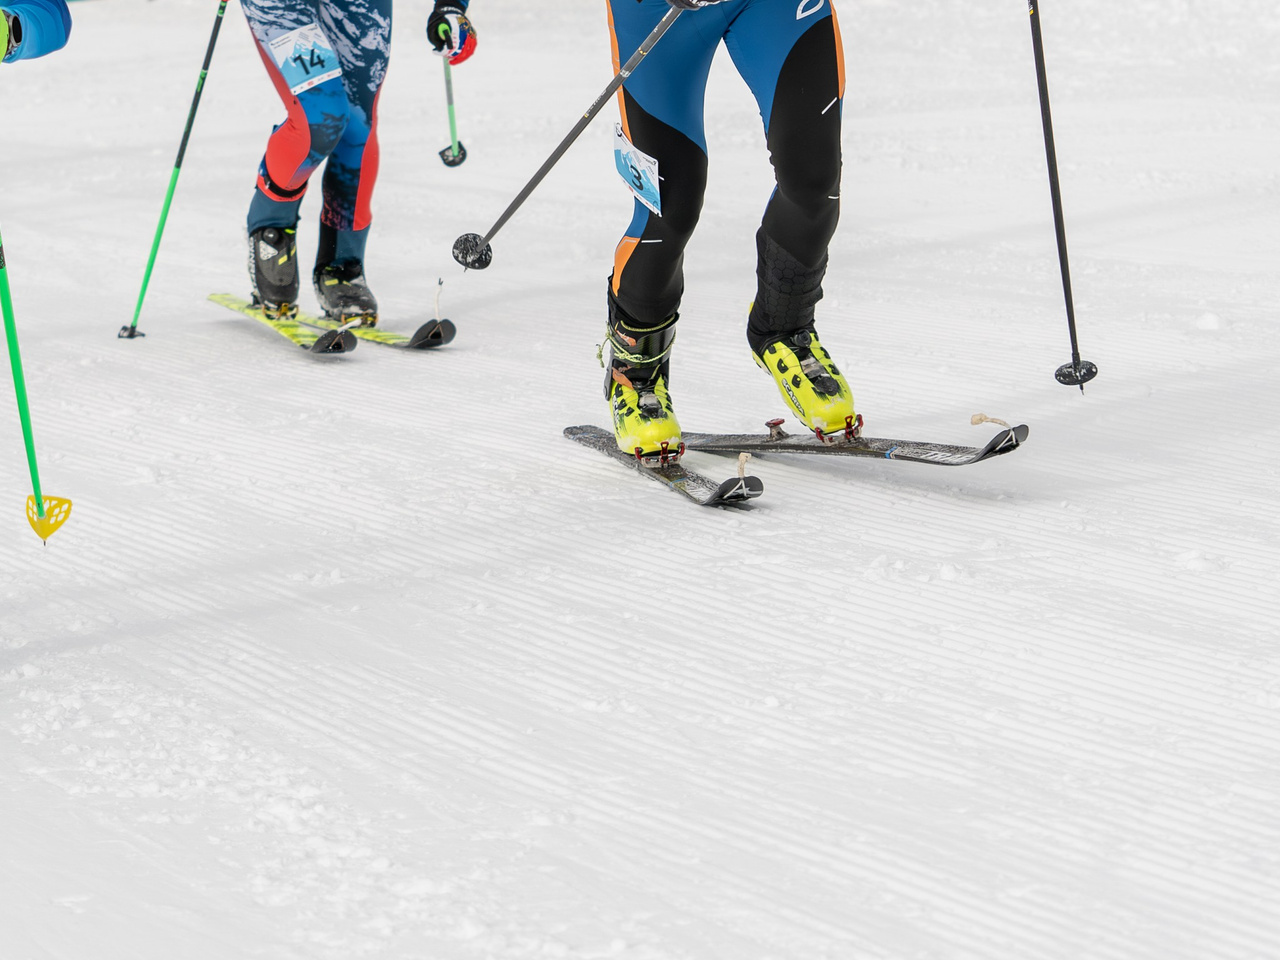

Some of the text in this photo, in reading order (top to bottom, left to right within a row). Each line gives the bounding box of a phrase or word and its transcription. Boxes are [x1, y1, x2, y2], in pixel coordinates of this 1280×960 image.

[294, 49, 325, 75] 14
[630, 165, 644, 191] 3
[781, 378, 806, 416] SCARPA
